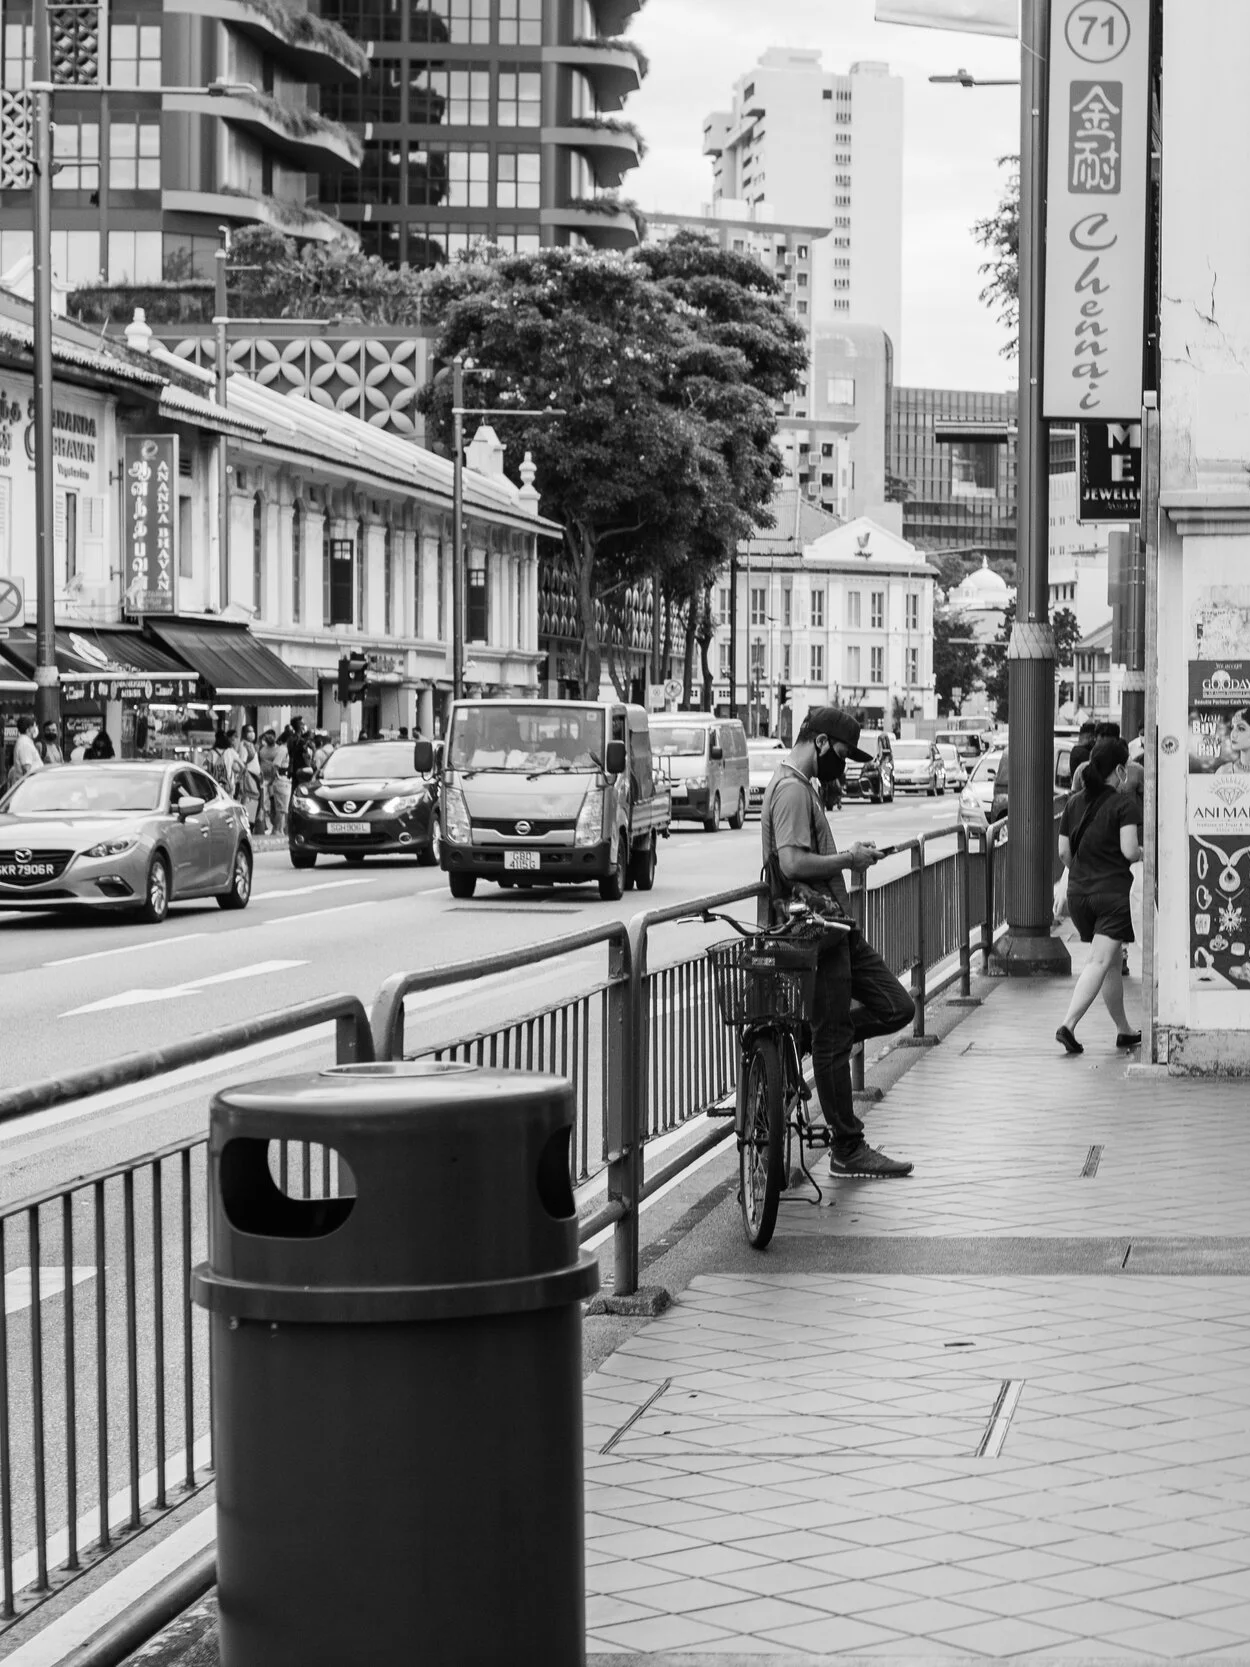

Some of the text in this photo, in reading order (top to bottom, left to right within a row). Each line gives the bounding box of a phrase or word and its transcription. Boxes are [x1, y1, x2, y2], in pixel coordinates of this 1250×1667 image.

[1079, 16, 1116, 46] 71
[1070, 213, 1117, 410] Chennai
[53, 409, 96, 437] NANDA
[157, 460, 169, 590] ANANDA BHAVAN
[1193, 720, 1217, 736] Buy
[1194, 807, 1219, 818] ANI
[0, 864, 54, 875] KR7906R
